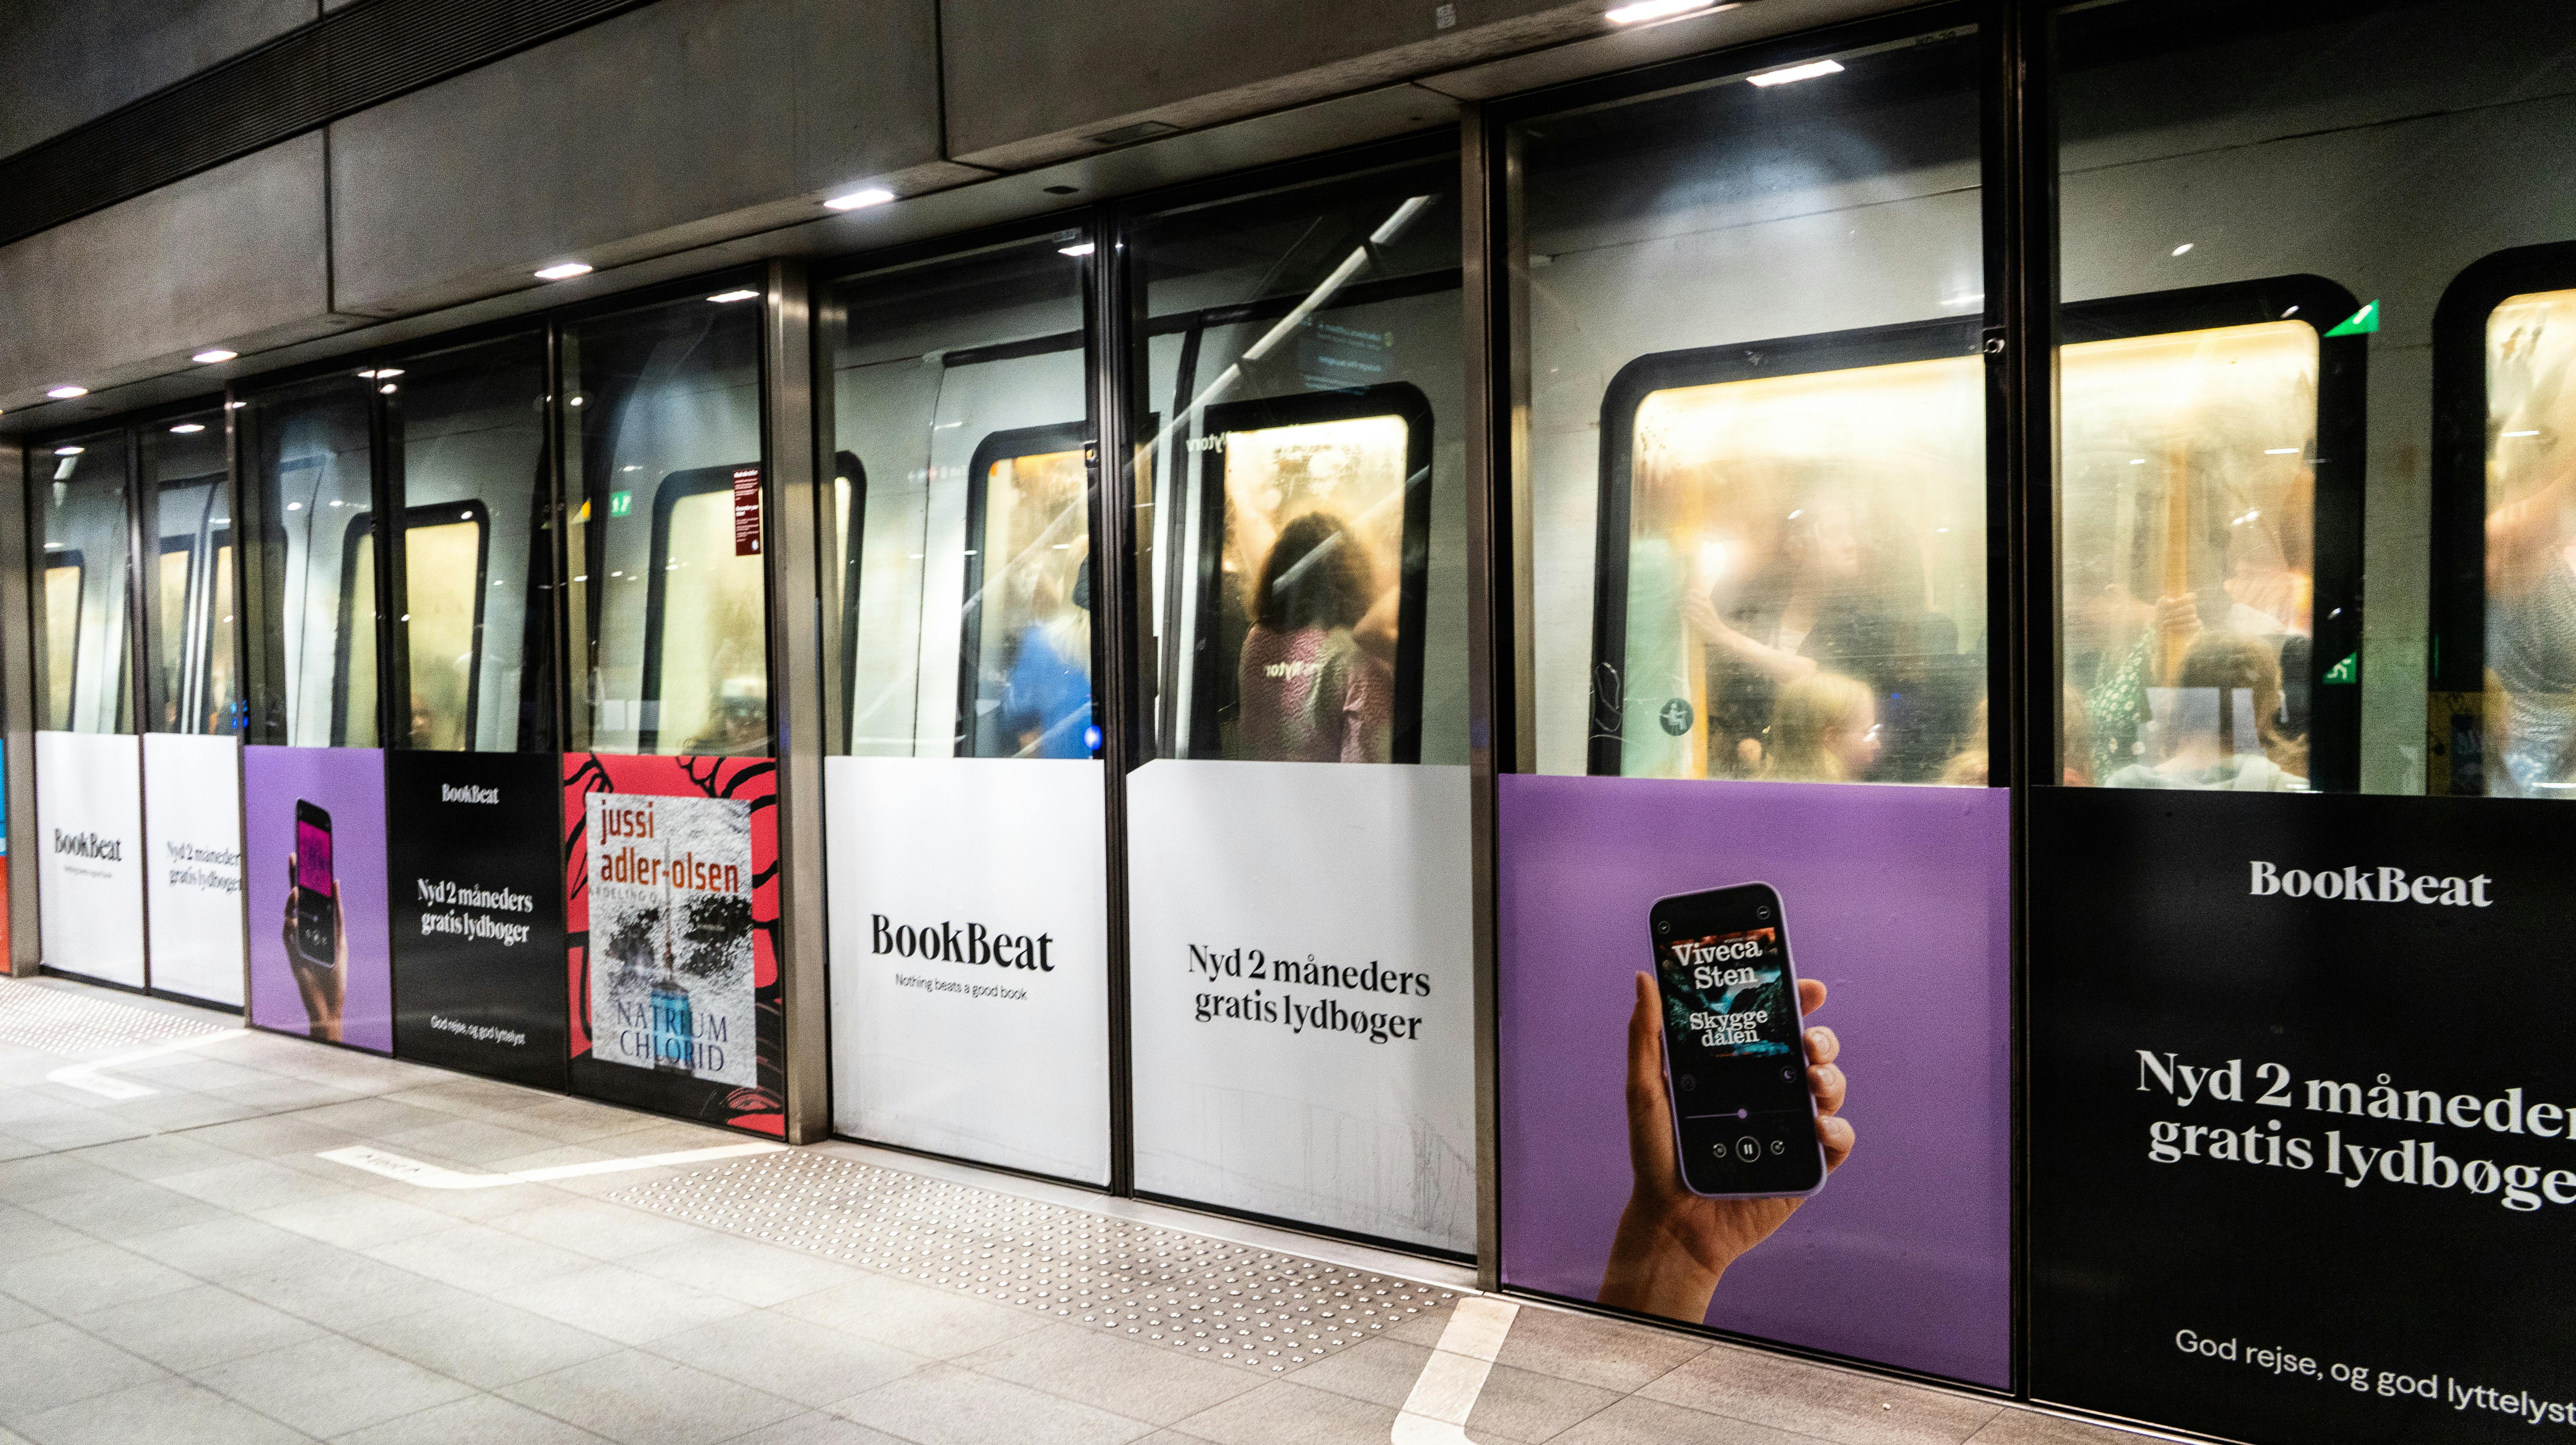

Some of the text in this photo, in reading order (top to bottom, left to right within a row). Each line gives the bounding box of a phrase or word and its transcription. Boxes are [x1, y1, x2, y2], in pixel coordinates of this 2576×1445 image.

[442, 783, 499, 804] BookBeat
[600, 799, 654, 845] jussi
[54, 828, 122, 862] BookBeat
[600, 846, 739, 893] adler-olsen
[2250, 860, 2493, 907] BookBeat
[417, 878, 533, 913] Nyd 2 måneders
[421, 909, 463, 936] gratis
[872, 914, 1055, 972] BookBeat
[1187, 943, 1431, 997] Nyd 2 måneders
[1671, 941, 1762, 966] Viveca
[895, 973, 1028, 1001] Nothing beats a good book
[1693, 966, 1758, 989] Sten
[617, 1002, 727, 1043] NATRIUM
[1195, 988, 1423, 1045] gratis lydbøger
[1689, 1010, 1768, 1033] Skygge
[1701, 1027, 1761, 1047] dalen
[620, 1029, 724, 1072] CHLORID
[2136, 1050, 2243, 1107] Nyd
[2255, 1062, 2292, 1107] 2
[2148, 1119, 2314, 1170] gratis
[2175, 1329, 2576, 1426] God rejse, og god lyttelyst
